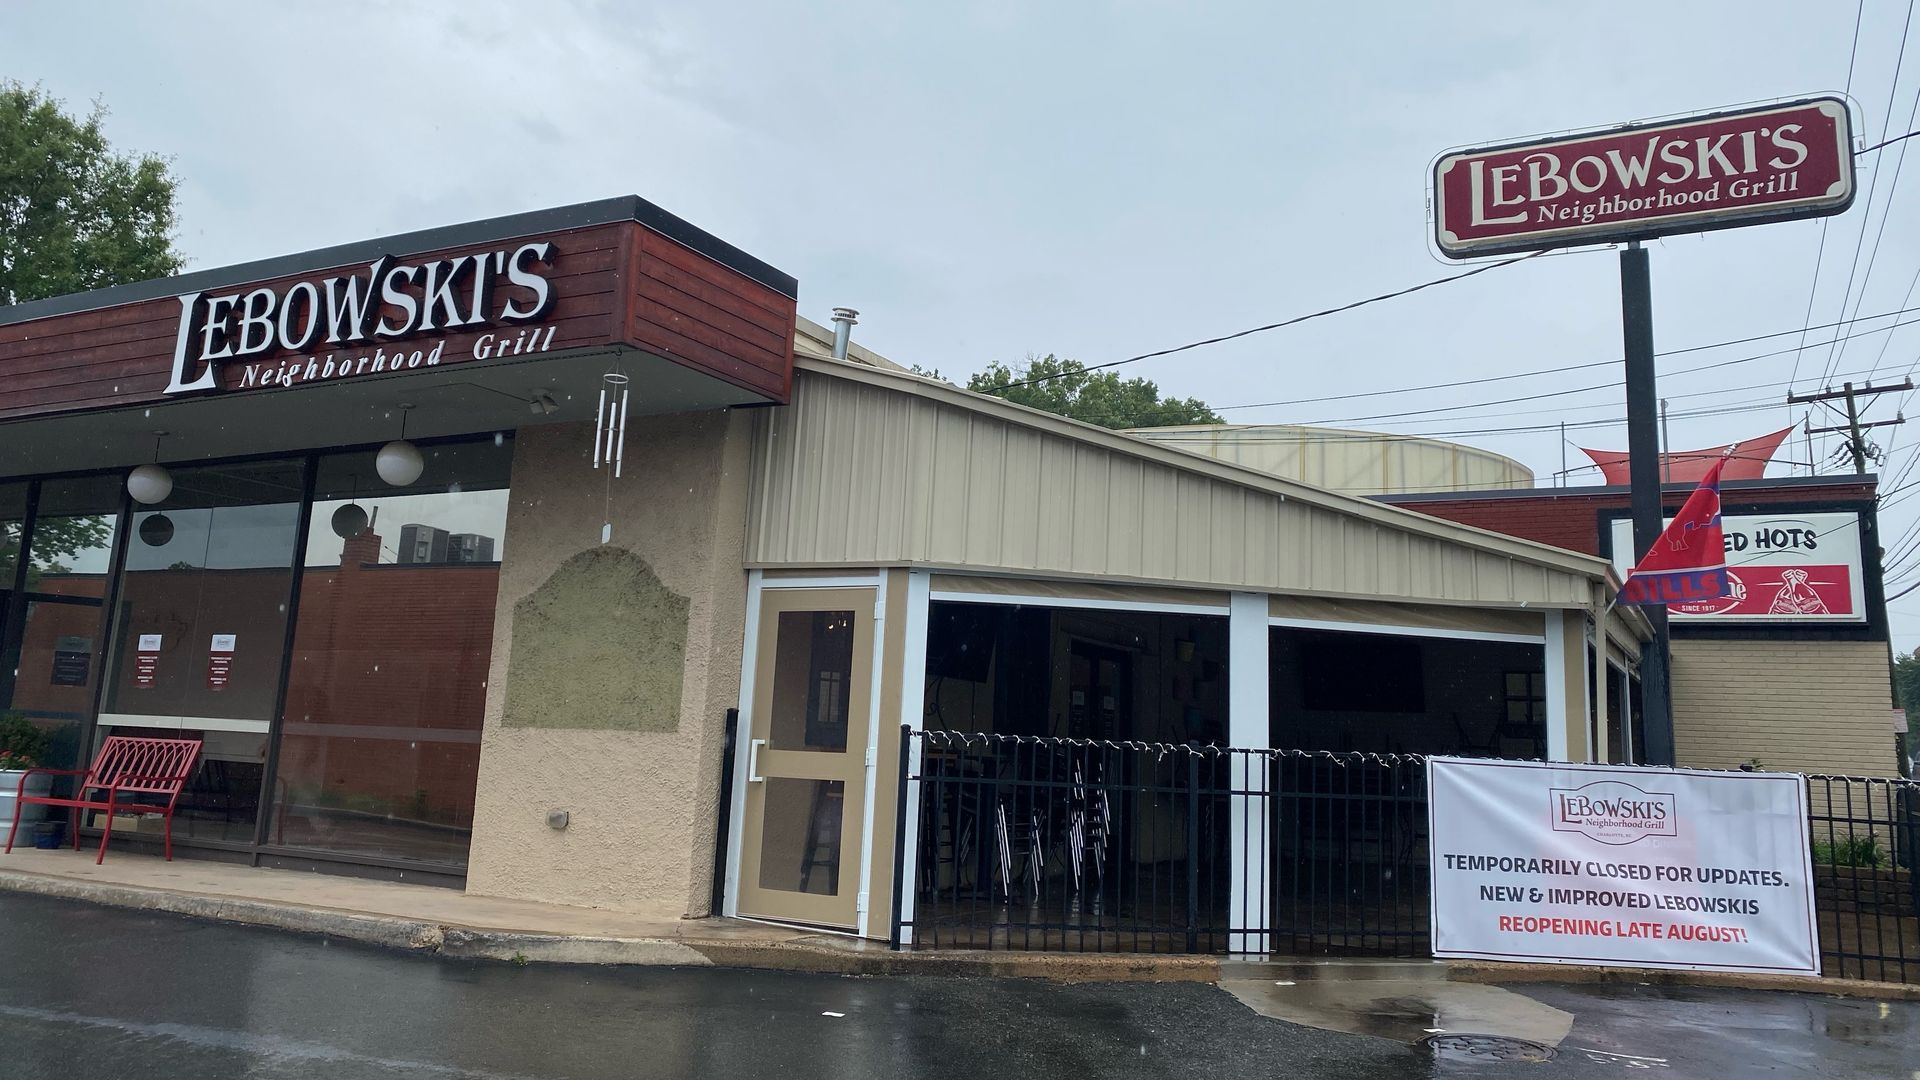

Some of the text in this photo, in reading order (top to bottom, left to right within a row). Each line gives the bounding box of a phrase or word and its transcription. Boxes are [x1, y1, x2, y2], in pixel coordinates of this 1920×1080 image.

[1469, 124, 1808, 226] LEBOWSKI'S
[1537, 171, 1799, 224] Neighborhood Grill
[162, 241, 557, 395] LEBOWSKI'S
[239, 326, 557, 388] Neighborhood Grill
[1723, 527, 1818, 552] ED HOTS
[1560, 794, 1667, 824] LEBOWSKI'S
[1586, 818, 1665, 830] Neighborhood Grill
[1444, 854, 1789, 887] TEMPORARILY CLOSED FOR UPDATES.
[1480, 885, 1760, 915] NEW & IMPROVED LEBOWSKIS
[1499, 915, 1749, 943] REOPENING LATE AUGUST!
